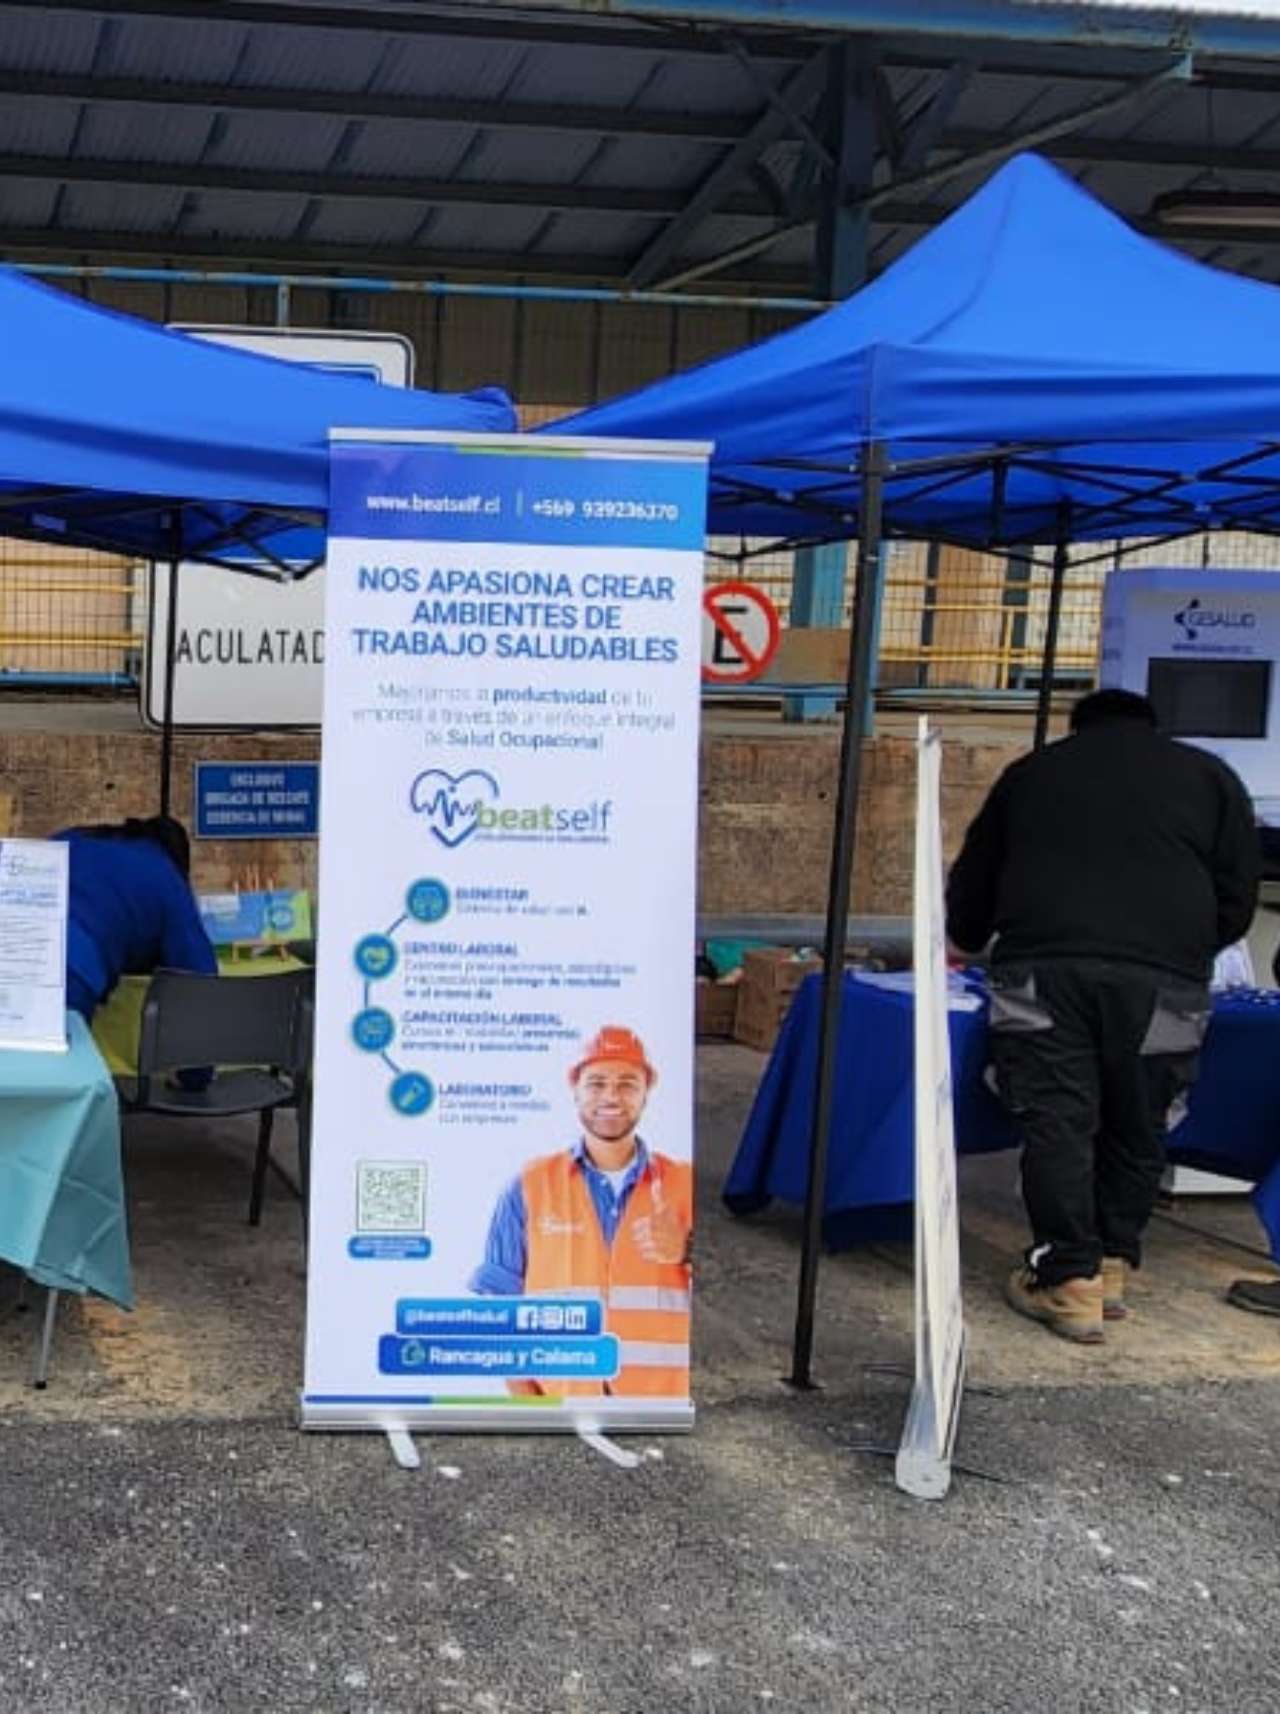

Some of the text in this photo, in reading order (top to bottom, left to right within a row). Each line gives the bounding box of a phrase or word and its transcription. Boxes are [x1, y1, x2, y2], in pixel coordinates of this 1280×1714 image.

[366, 493, 501, 514] www.beatself.cl
[532, 500, 575, 518] +569
[358, 566, 675, 601] NOS APASIONA CREAR
[411, 602, 621, 630] AMBIENTES DE
[352, 629, 679, 663] TRABAJO SALUDABLES
[493, 685, 607, 706] productividad
[446, 729, 495, 747] Salud
[498, 731, 604, 751] Ocupacional
[477, 800, 614, 833] beatself
[459, 943, 518, 957] LABORAL
[439, 1082, 532, 1096] LABORATORIO
[429, 1347, 597, 1368] Rancagua y Calama
